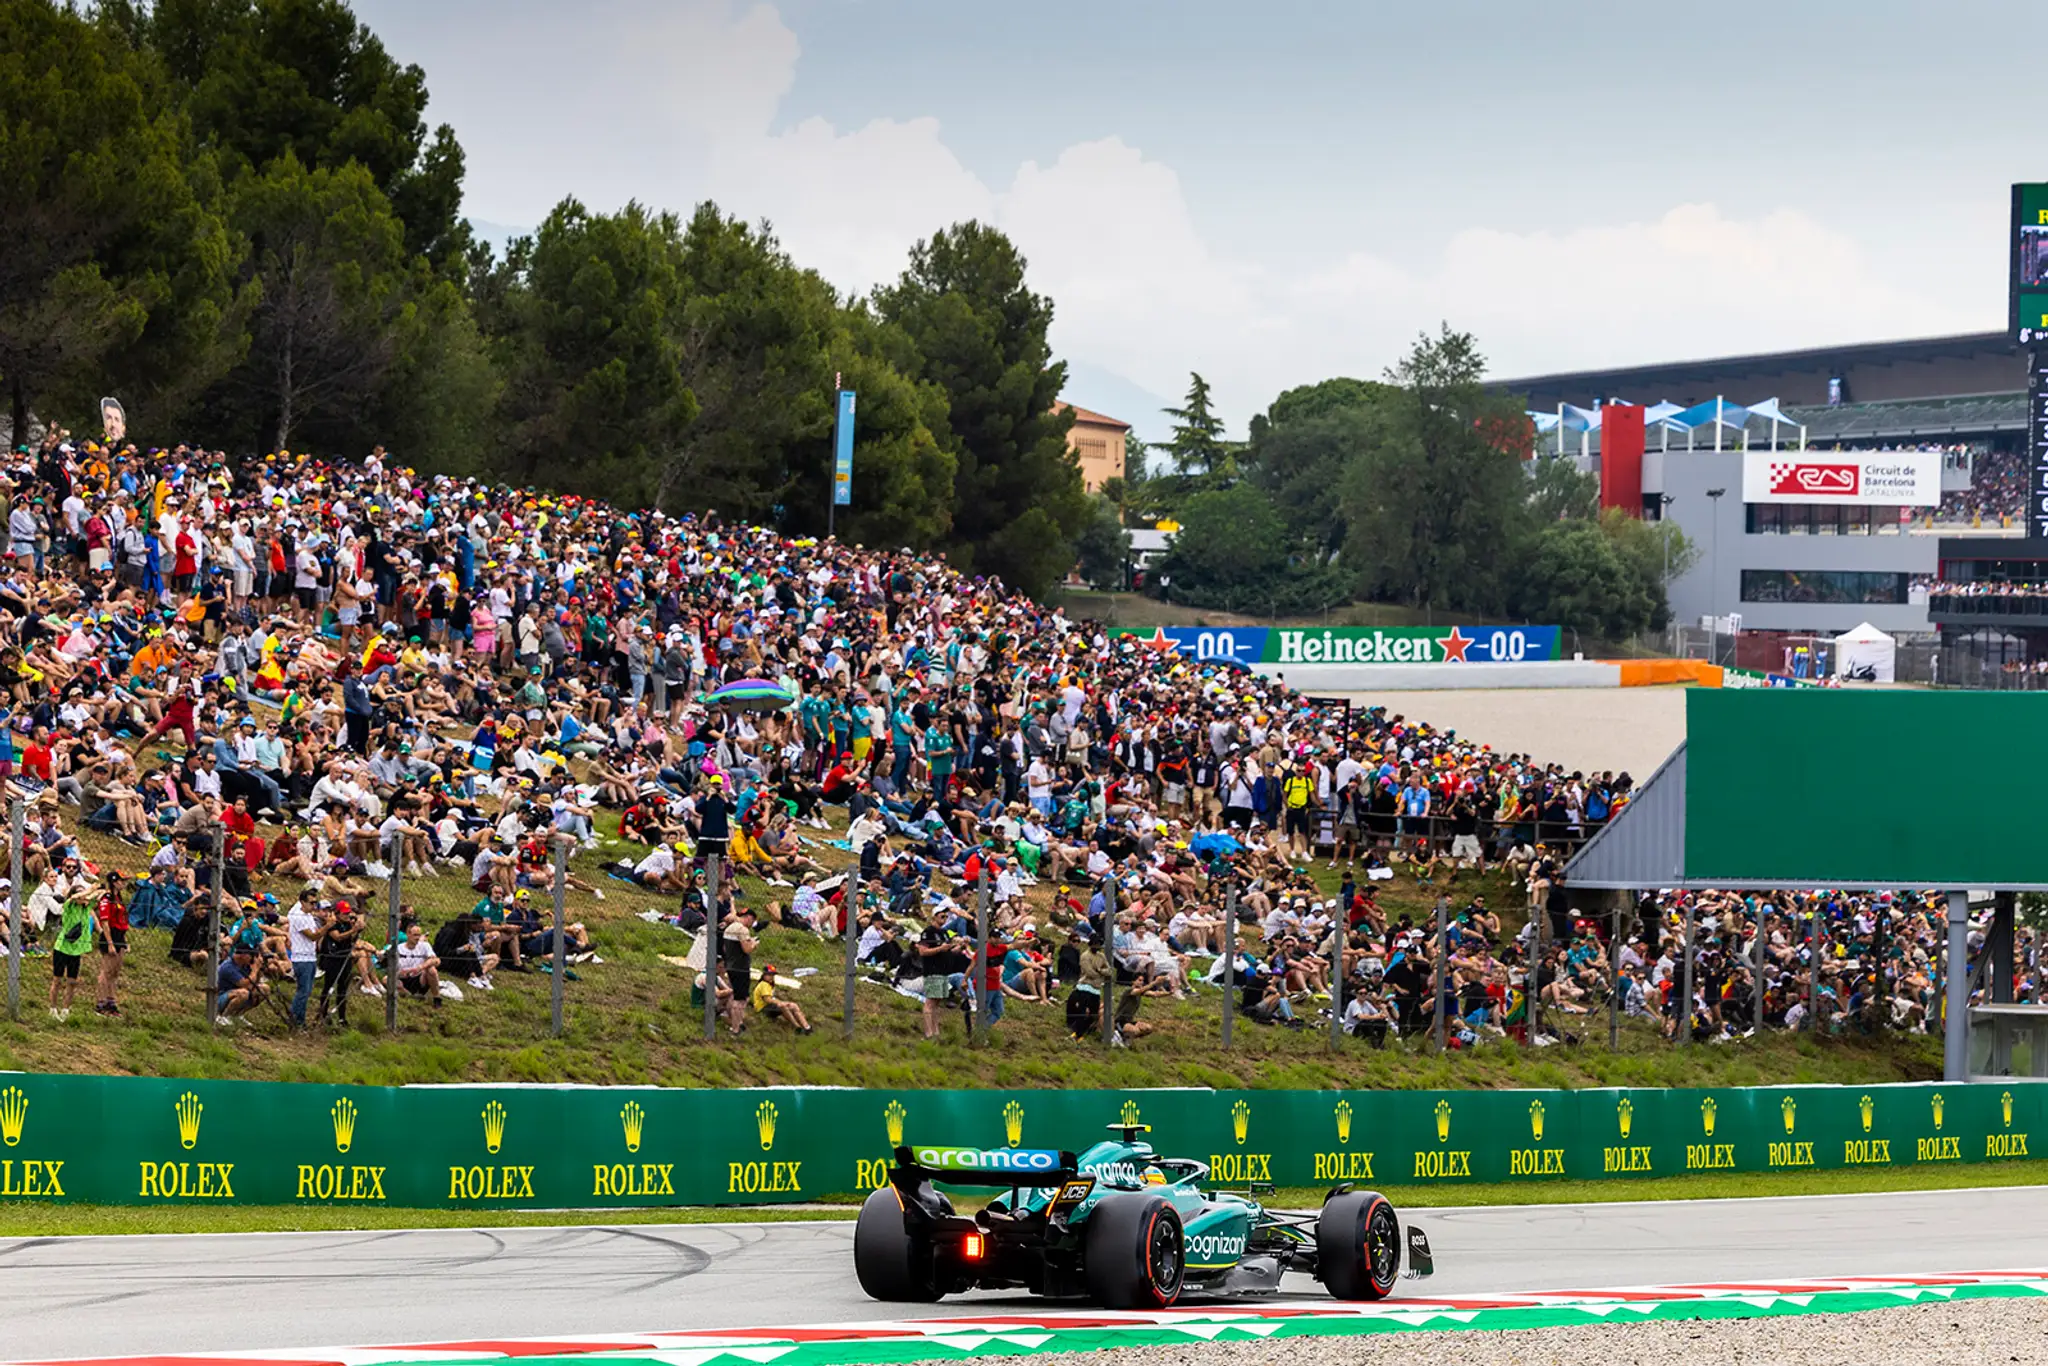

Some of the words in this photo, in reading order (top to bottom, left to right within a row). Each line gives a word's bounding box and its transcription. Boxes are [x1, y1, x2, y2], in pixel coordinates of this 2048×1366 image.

[1865, 464, 1901, 475] Circuit
[1903, 465, 1917, 475] de
[1865, 476, 1916, 487] Barcelona
[1279, 631, 1432, 662] Heineken
[1491, 630, 1525, 661] 0.0
[1687, 1145, 1734, 1168] ROLEX
[1769, 1143, 1814, 1166] ROLEX
[1845, 1140, 1890, 1163] ROLEX
[1918, 1138, 1960, 1160] ROLEX
[1986, 1135, 2028, 1156] ROLEX
[919, 1149, 1053, 1169] aramco
[1210, 1154, 1271, 1181] ROLEX
[1314, 1153, 1373, 1179] ROLEX
[1414, 1152, 1470, 1177] ROLEX
[1510, 1150, 1564, 1174] ROLEX
[1605, 1147, 1651, 1171] ROLEX
[140, 1162, 234, 1197] ROLEX
[297, 1165, 385, 1199] ROLEX
[448, 1166, 534, 1199] ROLEX
[594, 1164, 674, 1195] ROLEX
[729, 1162, 800, 1192] ROLEX
[1062, 1186, 1088, 1199] JCB
[1411, 1234, 1426, 1246] BOSS
